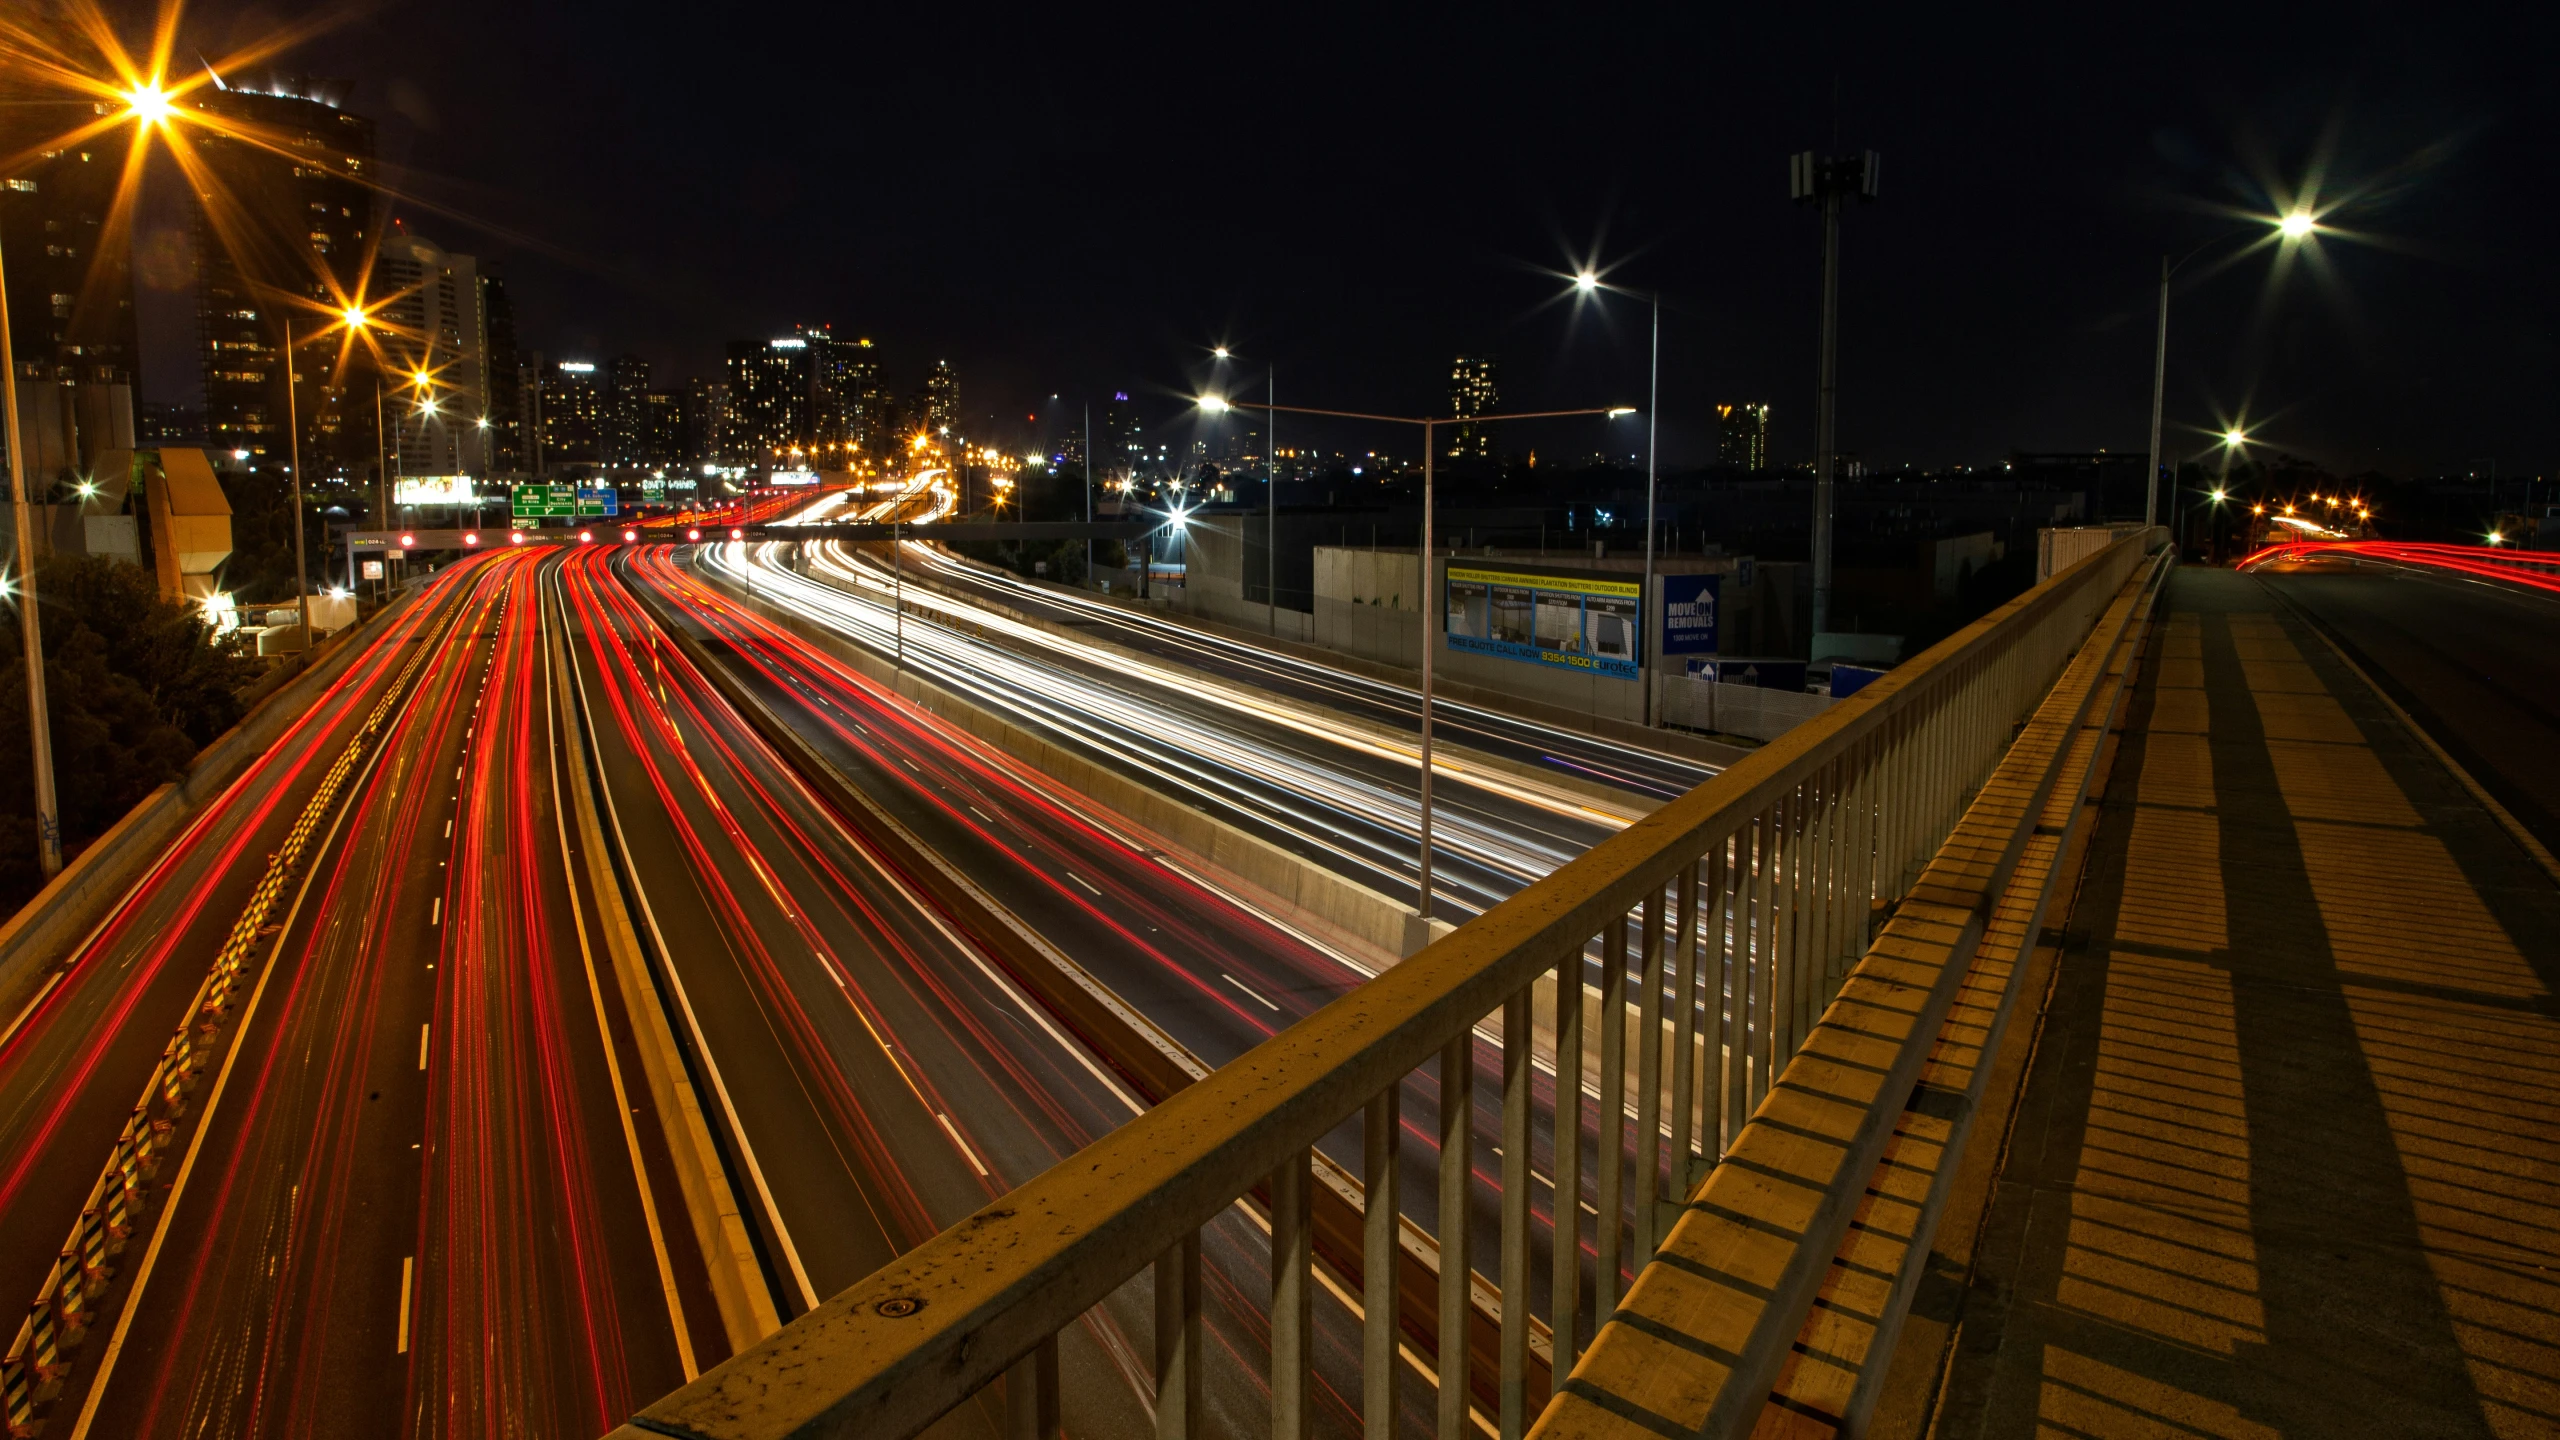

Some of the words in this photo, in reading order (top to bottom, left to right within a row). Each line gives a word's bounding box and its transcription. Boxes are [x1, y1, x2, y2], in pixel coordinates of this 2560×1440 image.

[1502, 575, 1518, 583] CANVAS
[1541, 580, 1568, 588] PLANTATION
[1568, 582, 1592, 590] SHUTTERS
[1595, 584, 1618, 592] OUTDOOR
[1619, 586, 1637, 594] BLINDS
[1668, 602, 1696, 617] MOVE
[1697, 601, 1712, 617] ON
[1668, 616, 1714, 629] REMOVALS
[1673, 634, 1684, 642] 1300
[1684, 633, 1699, 641] MOVE
[1700, 632, 1709, 640] ON
[1449, 636, 1467, 647] FREE
[1469, 640, 1495, 652] QUOTE
[1496, 645, 1517, 655] CALL
[1519, 648, 1539, 659] NOW
[1542, 651, 1566, 663] 9354
[1567, 656, 1590, 668] 1500
